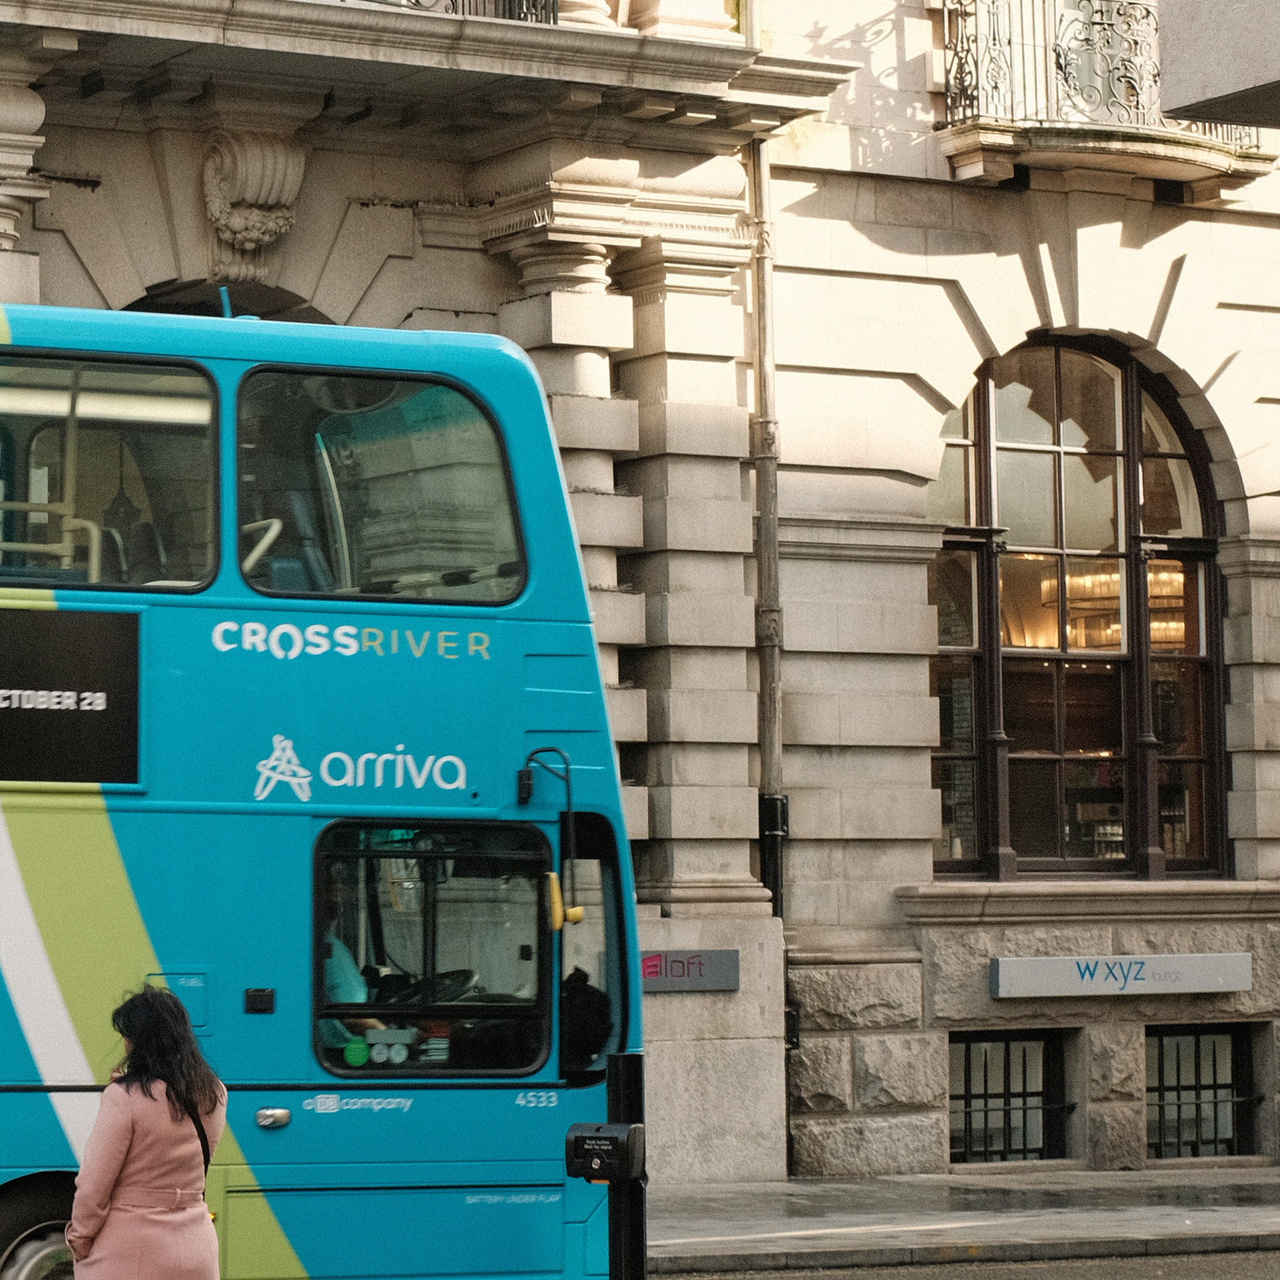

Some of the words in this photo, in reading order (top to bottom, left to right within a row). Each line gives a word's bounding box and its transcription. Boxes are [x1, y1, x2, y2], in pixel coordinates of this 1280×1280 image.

[79, 692, 108, 711] 28
[319, 744, 467, 790] arriva
[641, 953, 704, 979] aloft
[341, 1097, 414, 1113] company
[515, 1092, 558, 1107] 4533
